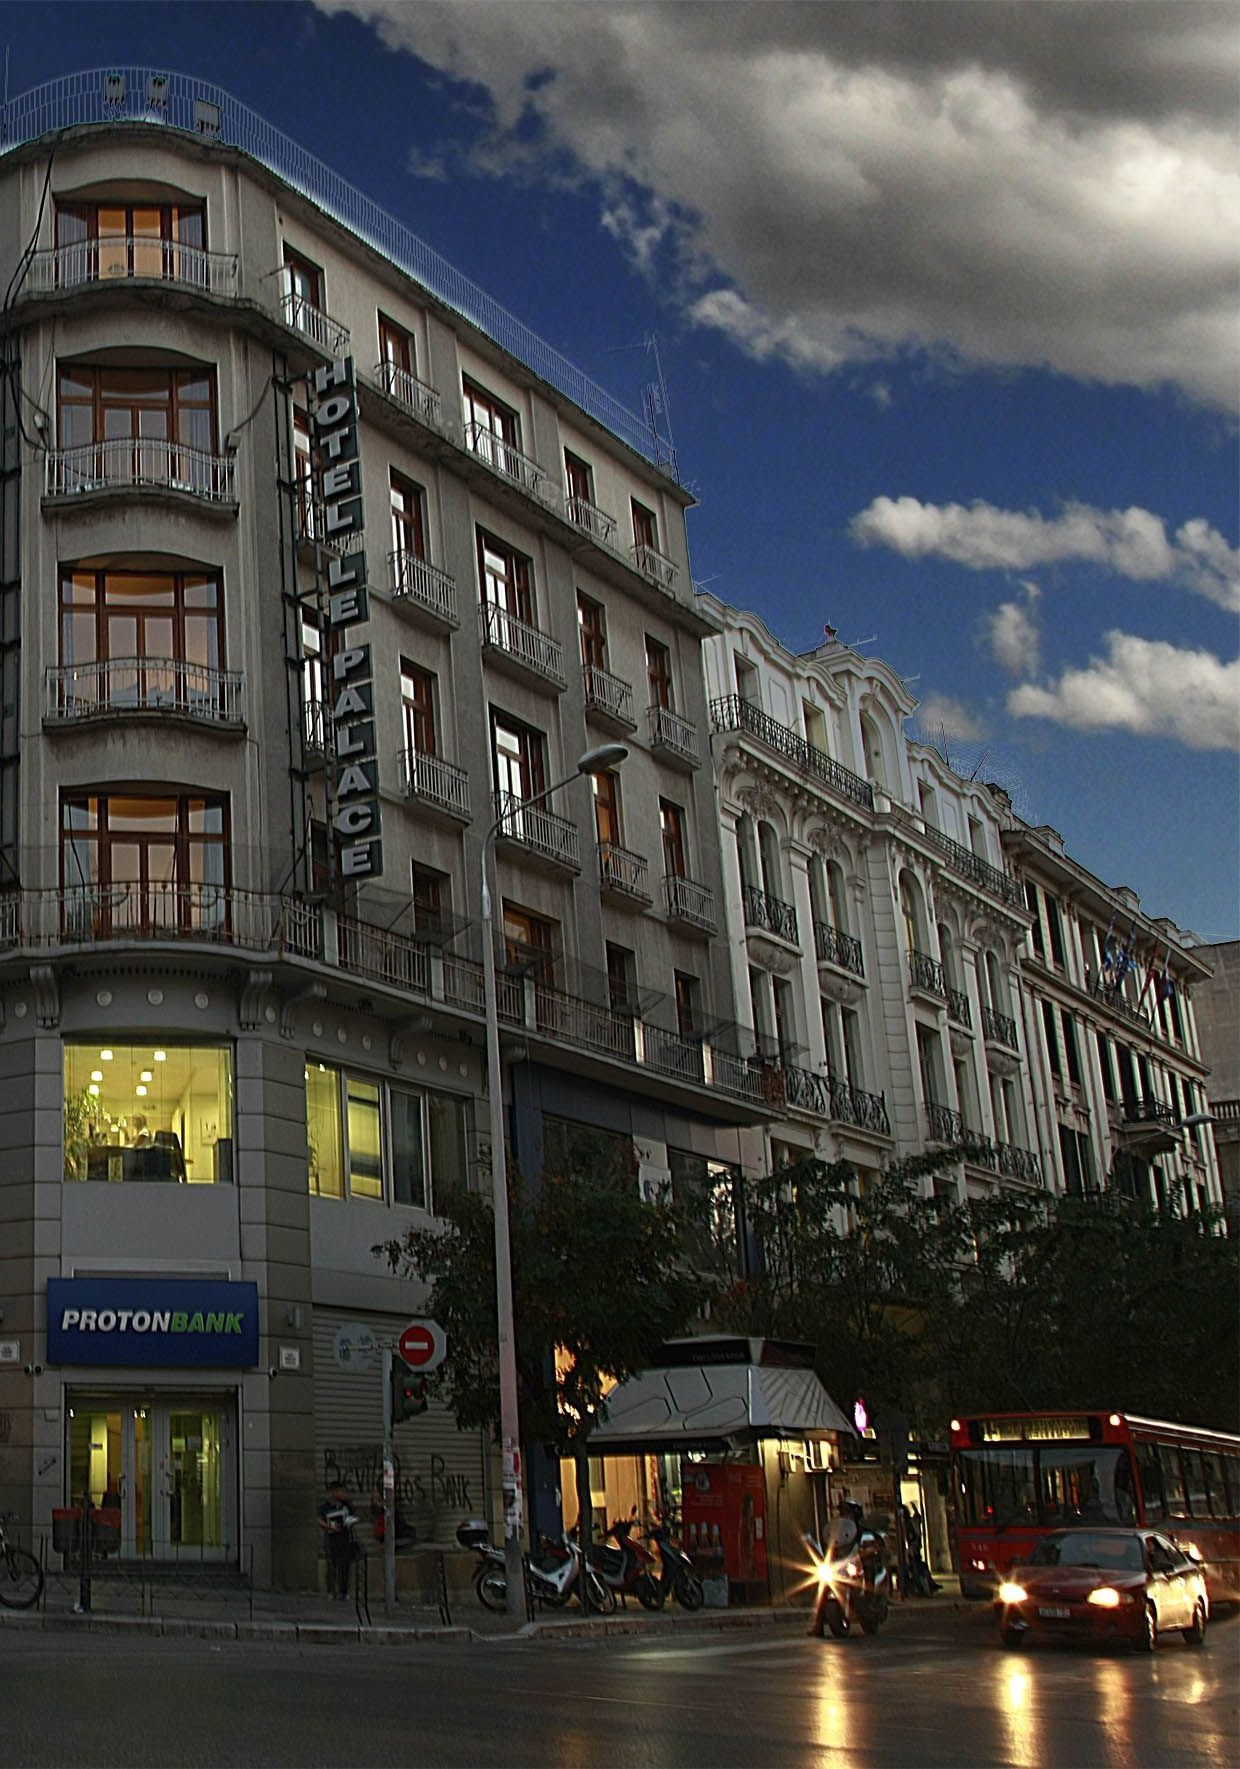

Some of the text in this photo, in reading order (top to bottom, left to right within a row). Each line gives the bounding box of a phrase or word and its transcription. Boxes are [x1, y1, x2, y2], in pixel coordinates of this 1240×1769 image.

[315, 357, 373, 876] HOTEL LE PALACE
